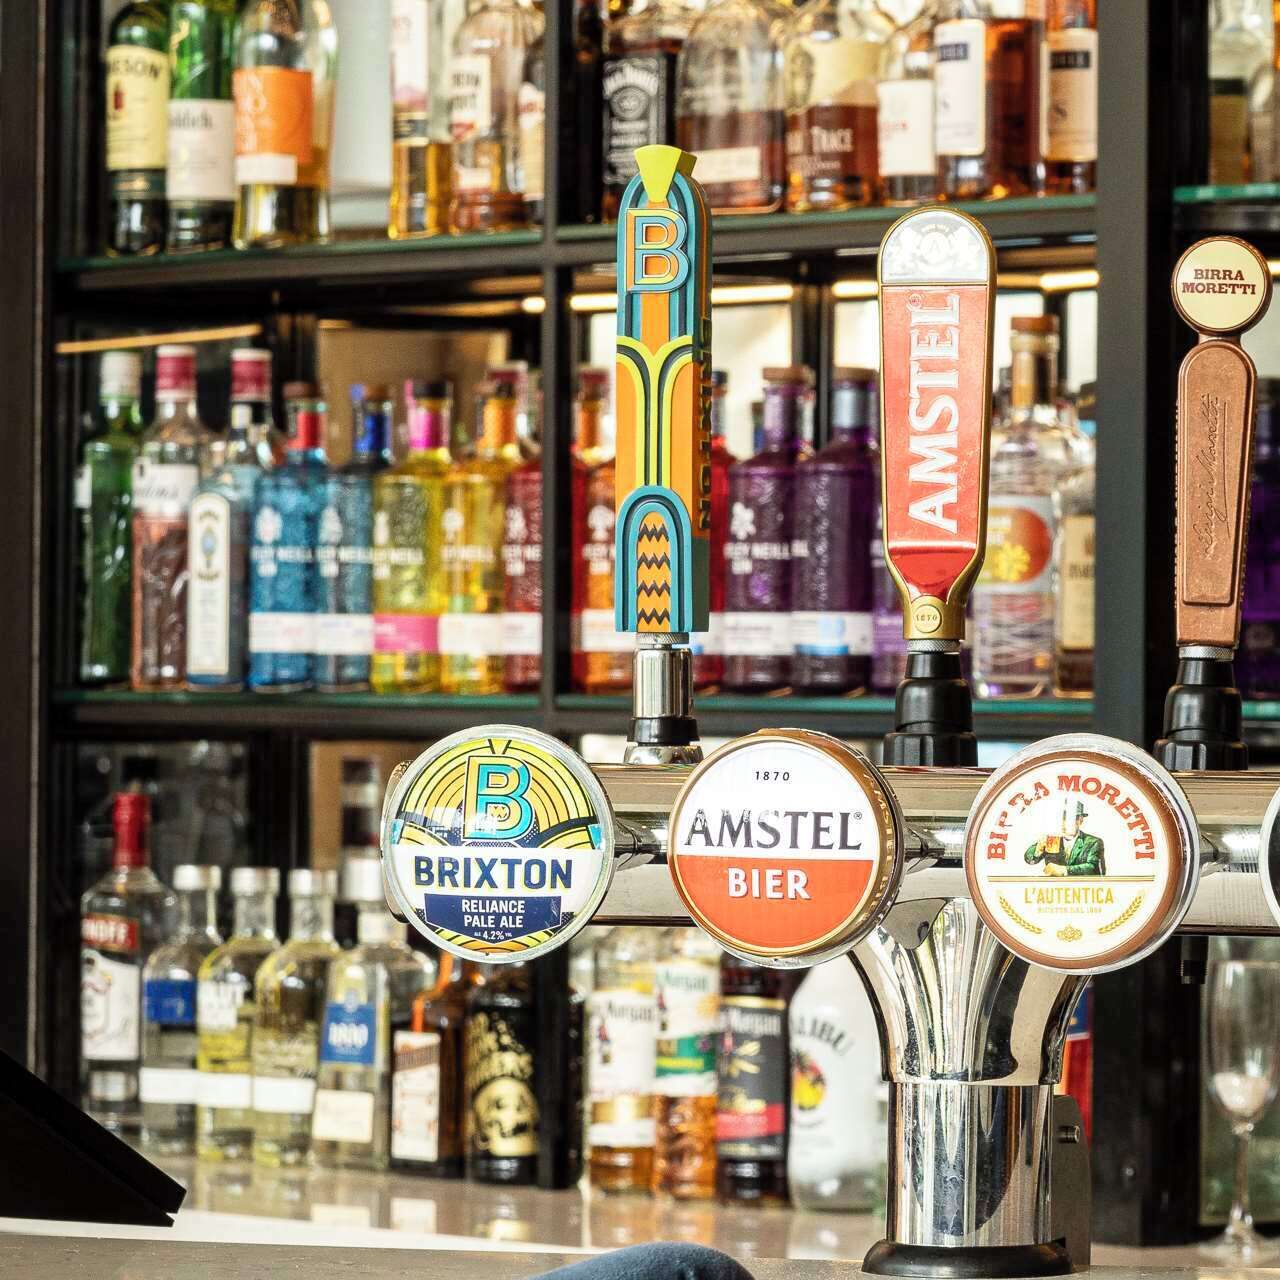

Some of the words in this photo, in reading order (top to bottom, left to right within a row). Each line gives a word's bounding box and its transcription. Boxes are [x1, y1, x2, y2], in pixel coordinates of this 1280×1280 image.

[625, 207, 691, 293] B
[1193, 268, 1245, 282] BIRRA
[1181, 282, 1257, 296] MORETTI
[907, 293, 960, 535] AMSTEL
[754, 771, 790, 781] 1870
[463, 755, 534, 841] B
[683, 808, 862, 851] AMSTEL
[1056, 774, 1156, 860] MORETTI
[414, 855, 573, 890] BRIXTON
[727, 867, 812, 901] BIER
[461, 898, 526, 914] RELIANCE
[1023, 886, 1115, 905] L'AUTENTICA
[463, 914, 496, 928] PALE
[499, 914, 524, 928] ALE
[482, 931, 505, 941] 4.2%
